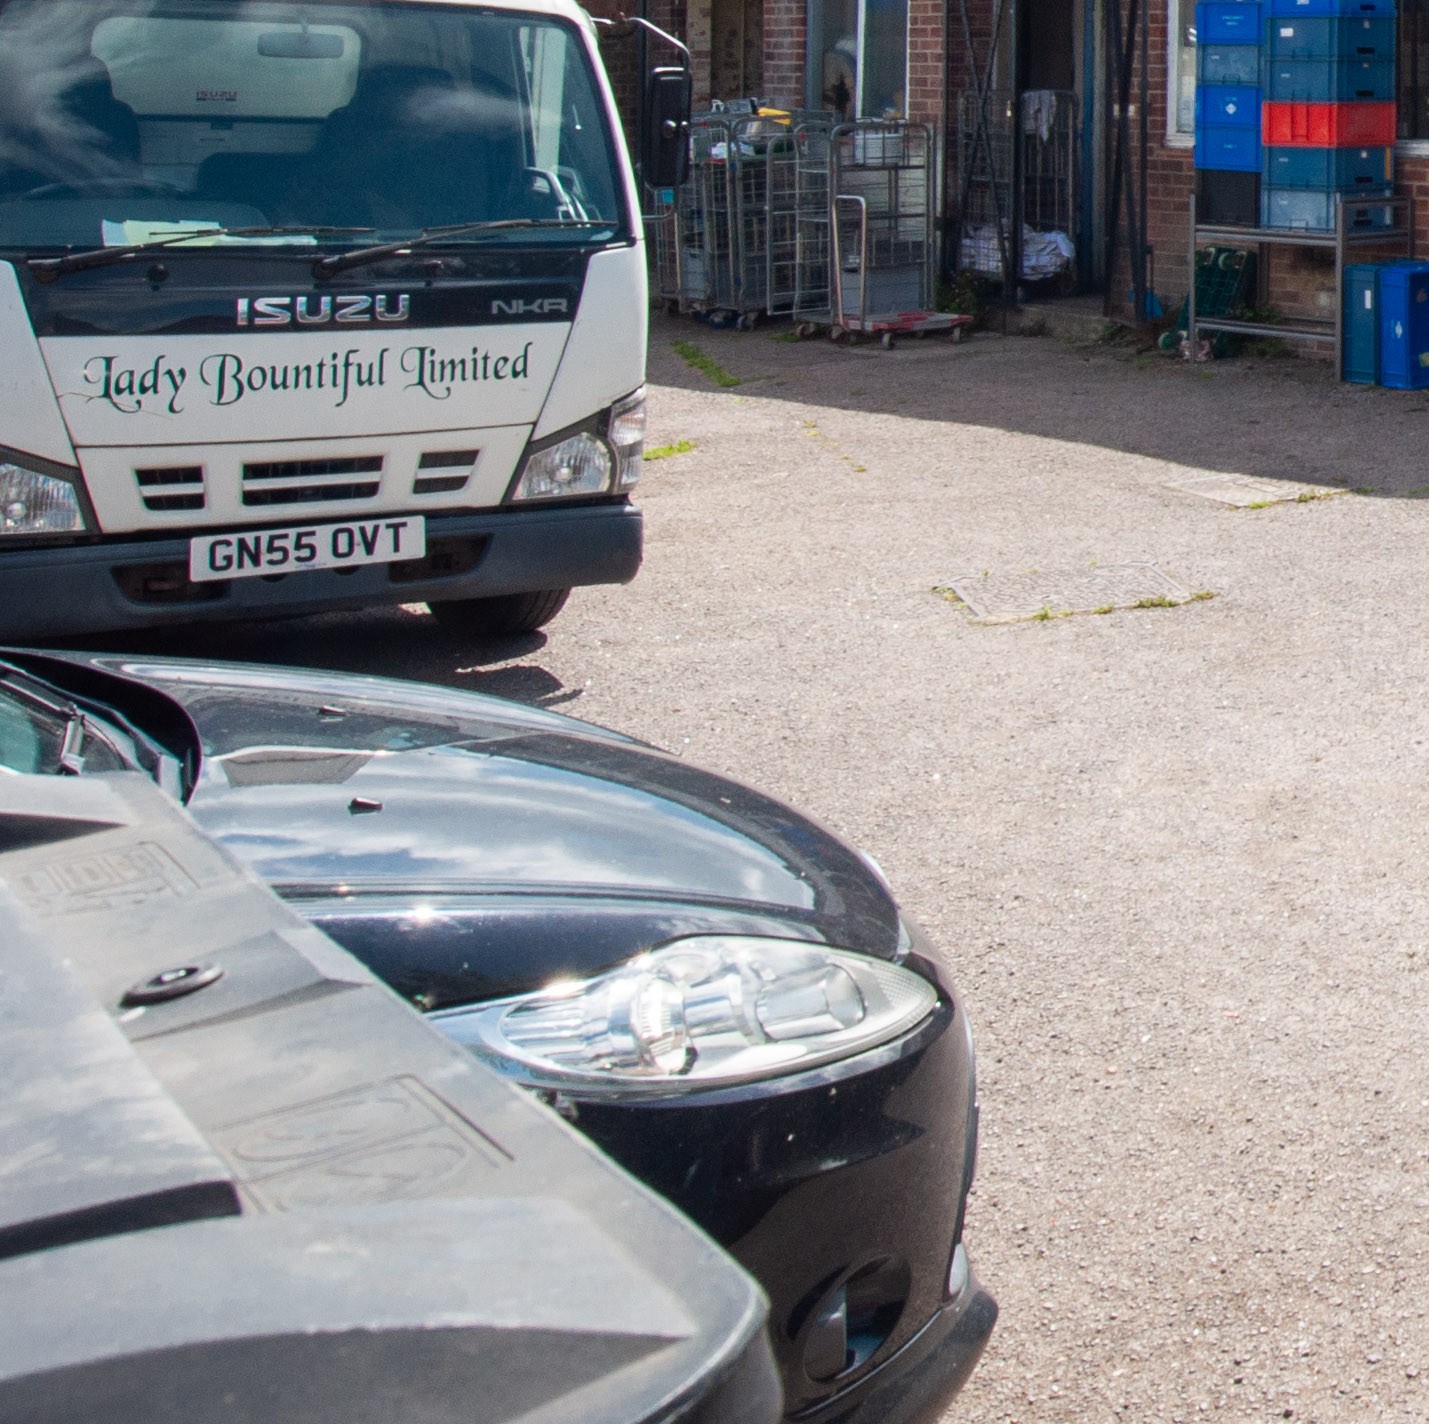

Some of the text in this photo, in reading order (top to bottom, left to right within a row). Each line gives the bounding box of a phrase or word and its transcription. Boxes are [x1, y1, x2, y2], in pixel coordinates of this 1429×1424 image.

[236, 293, 410, 325] ISUZU
[490, 298, 568, 315] NKR
[83, 341, 534, 414] Lady Bountiful Limited
[208, 521, 408, 572] GN55 OVT
